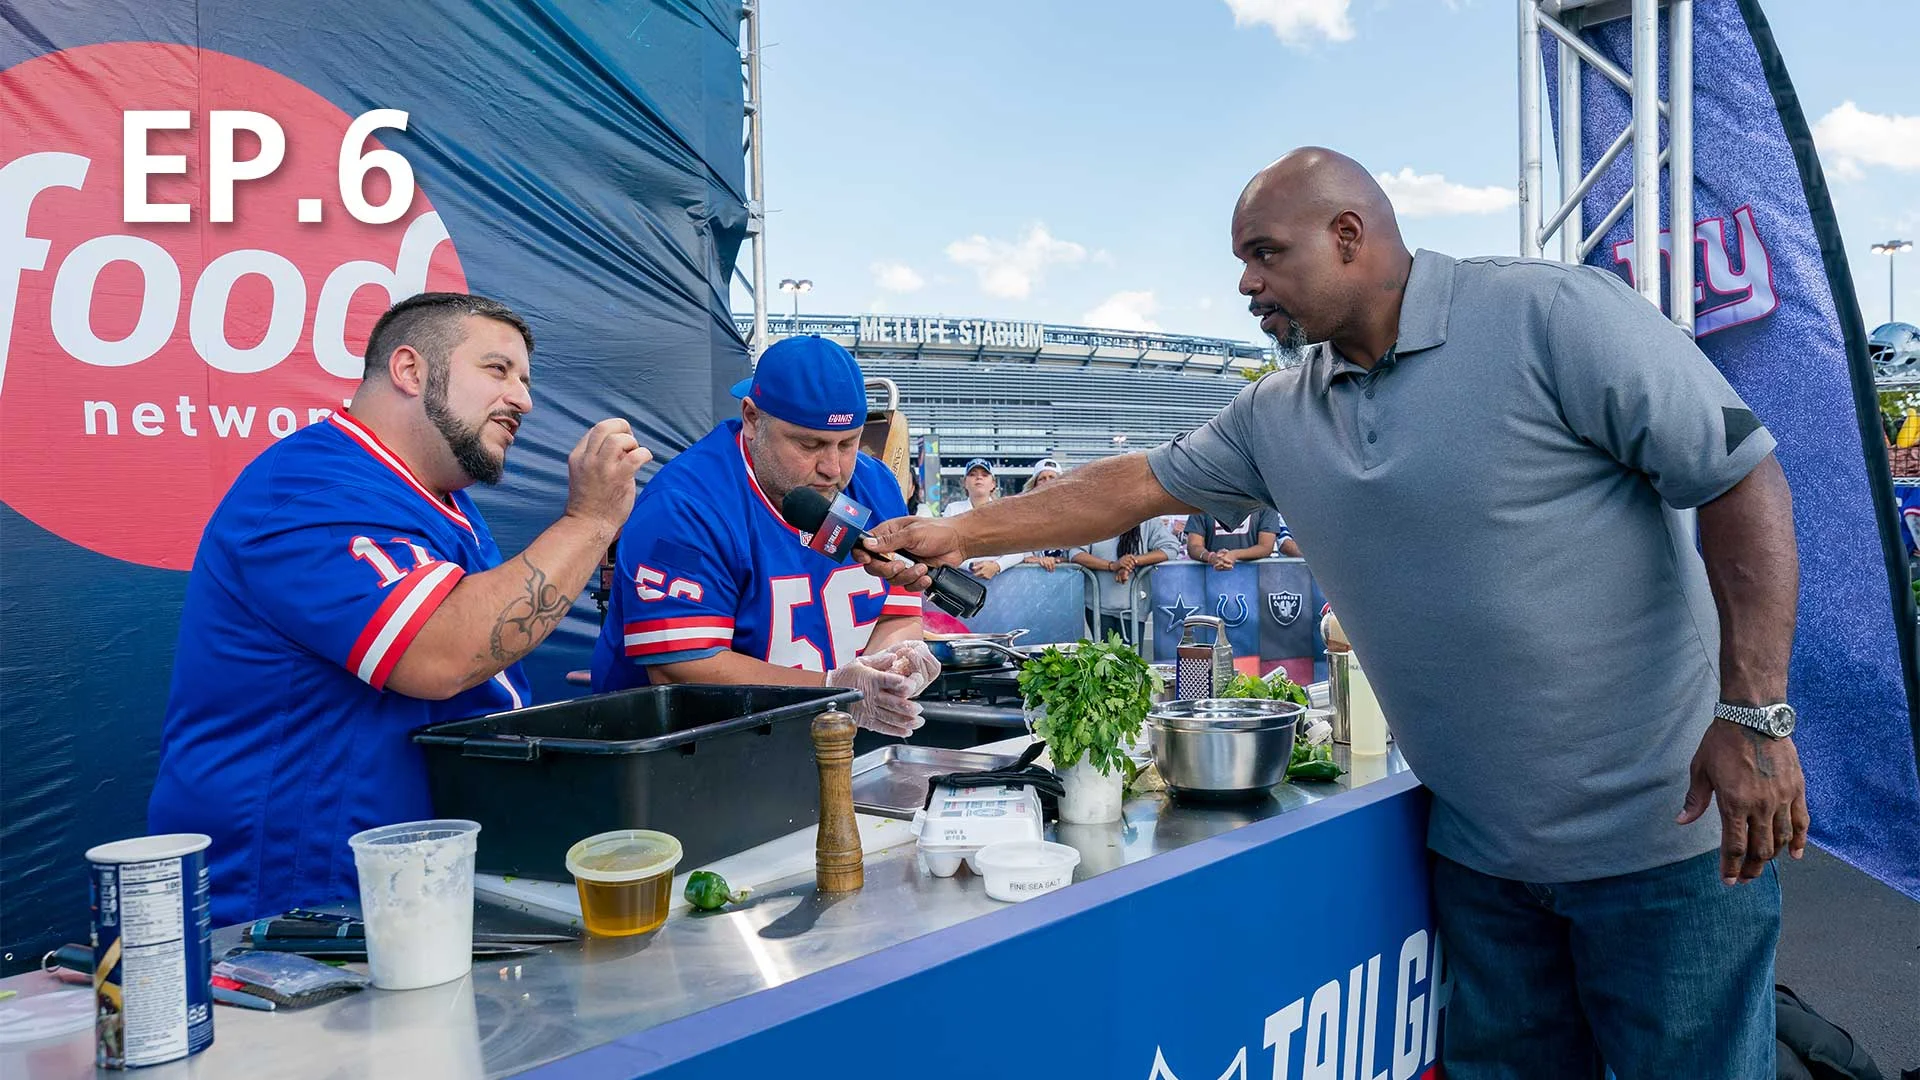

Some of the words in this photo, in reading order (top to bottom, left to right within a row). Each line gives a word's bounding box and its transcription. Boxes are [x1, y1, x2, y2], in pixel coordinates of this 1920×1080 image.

[860, 316, 950, 344] METLIFE
[958, 320, 1044, 348] STADIUM
[84, 395, 352, 438] networ
[827, 413, 854, 424] GIANTS
[1009, 883, 1026, 891] FINE
[1028, 882, 1043, 890] SEA
[1044, 878, 1061, 889] SALT
